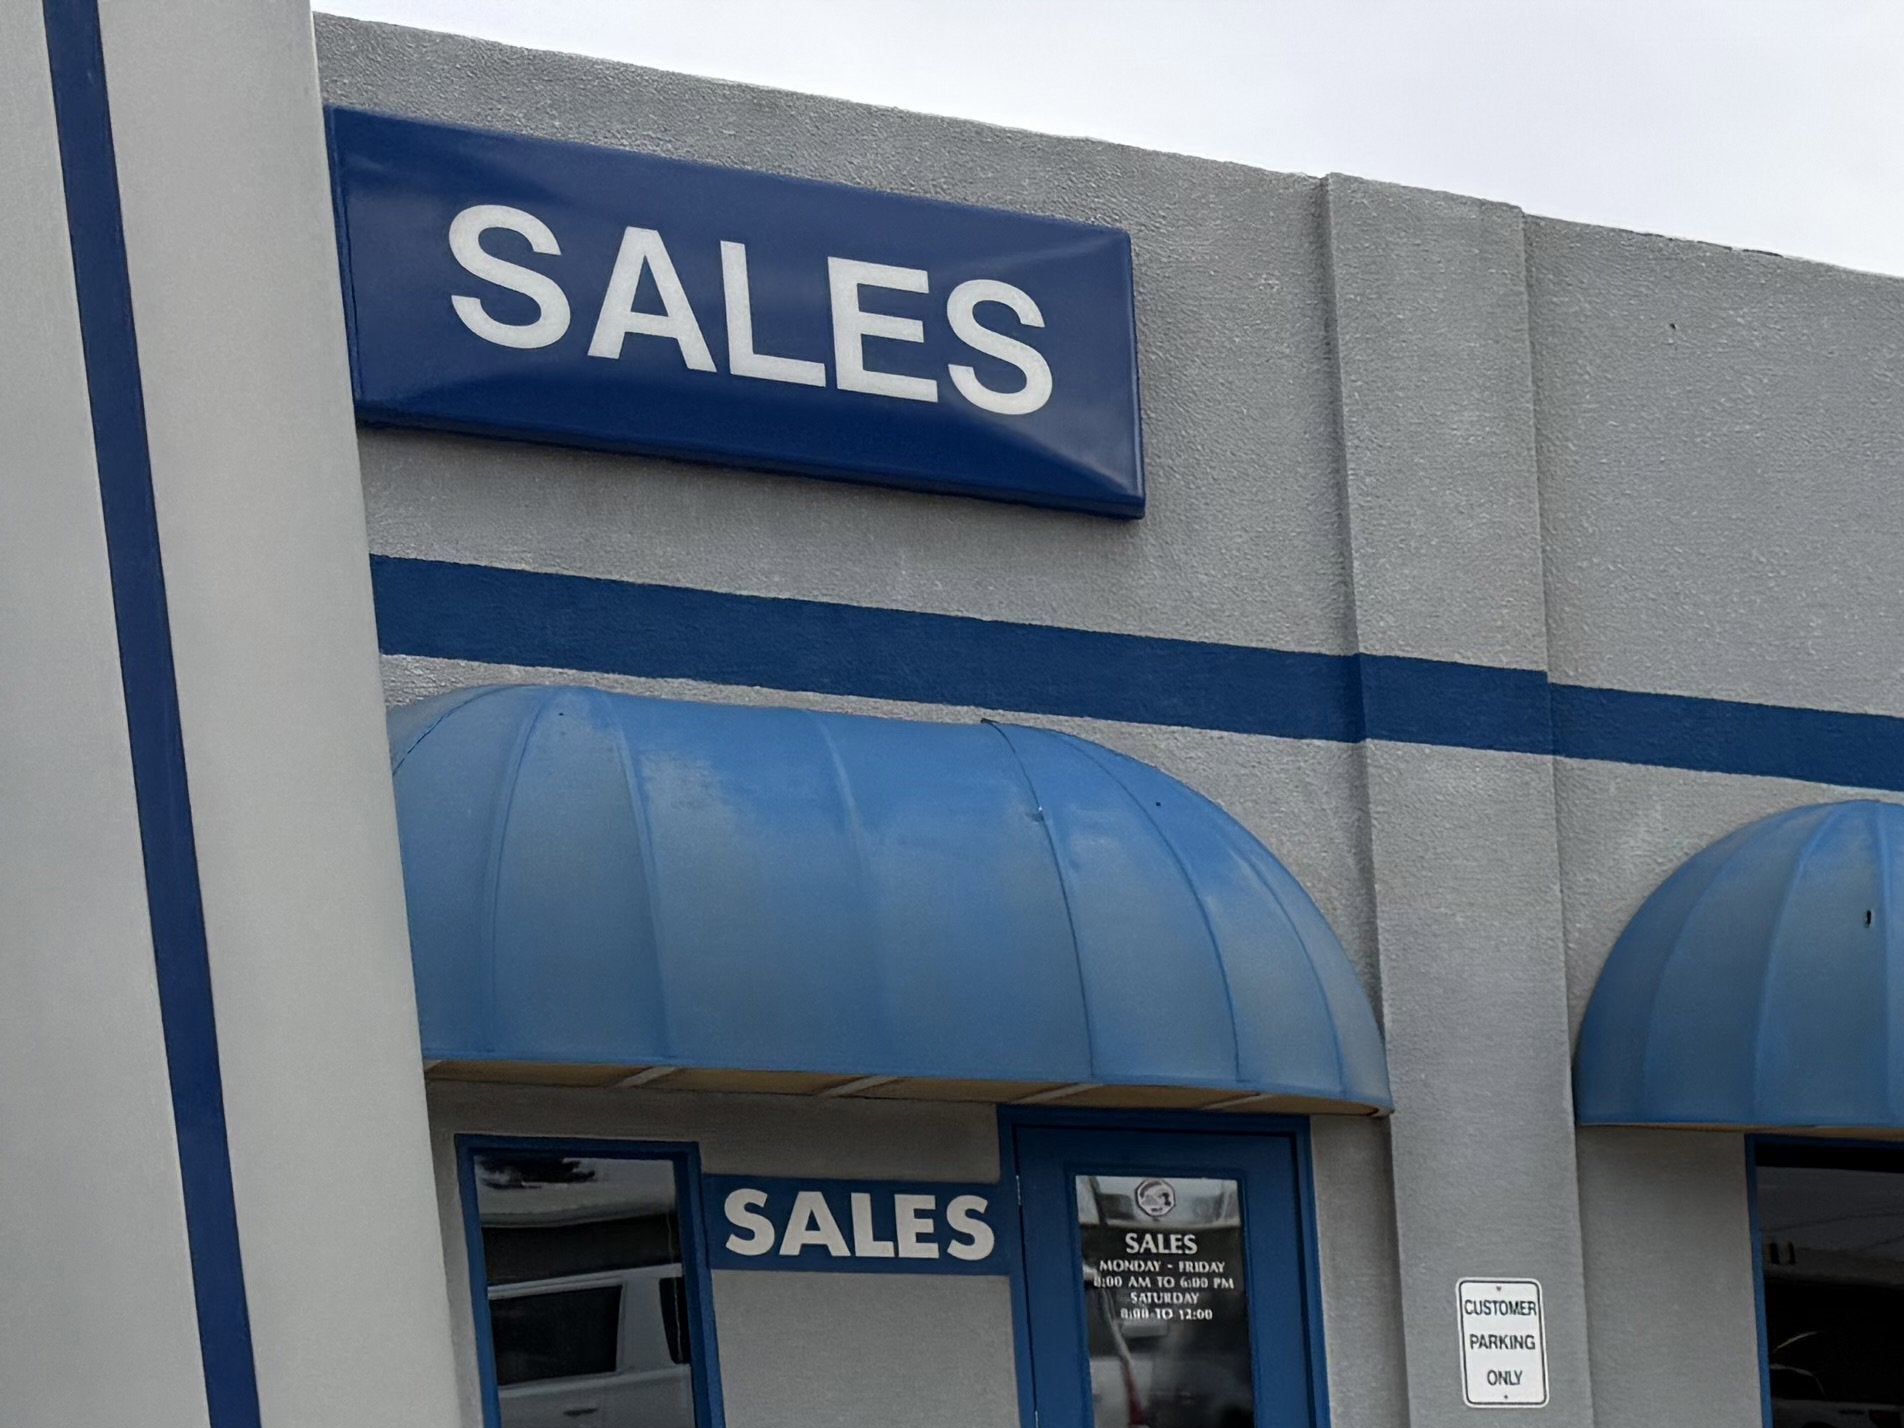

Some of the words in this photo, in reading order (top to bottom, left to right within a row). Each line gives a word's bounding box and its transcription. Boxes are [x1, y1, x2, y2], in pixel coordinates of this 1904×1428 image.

[447, 204, 1054, 416] SALES
[723, 1187, 996, 1262] SALES
[1125, 1232, 1198, 1254] SALES
[1100, 1259, 1161, 1272] MONDAY
[1178, 1261, 1225, 1273] FRIDAY
[1128, 1276, 1151, 1288] AM
[1157, 1277, 1175, 1289] TO
[1180, 1277, 1209, 1289] 6:00
[1213, 1278, 1235, 1289] PM
[1130, 1291, 1200, 1305] SATURDAY
[1155, 1308, 1173, 1320] TO
[1179, 1309, 1213, 1321] 12:00
[1464, 1299, 1537, 1316] CUSTOMER
[1469, 1333, 1536, 1350] PARKING
[1487, 1369, 1523, 1386] ONLY
